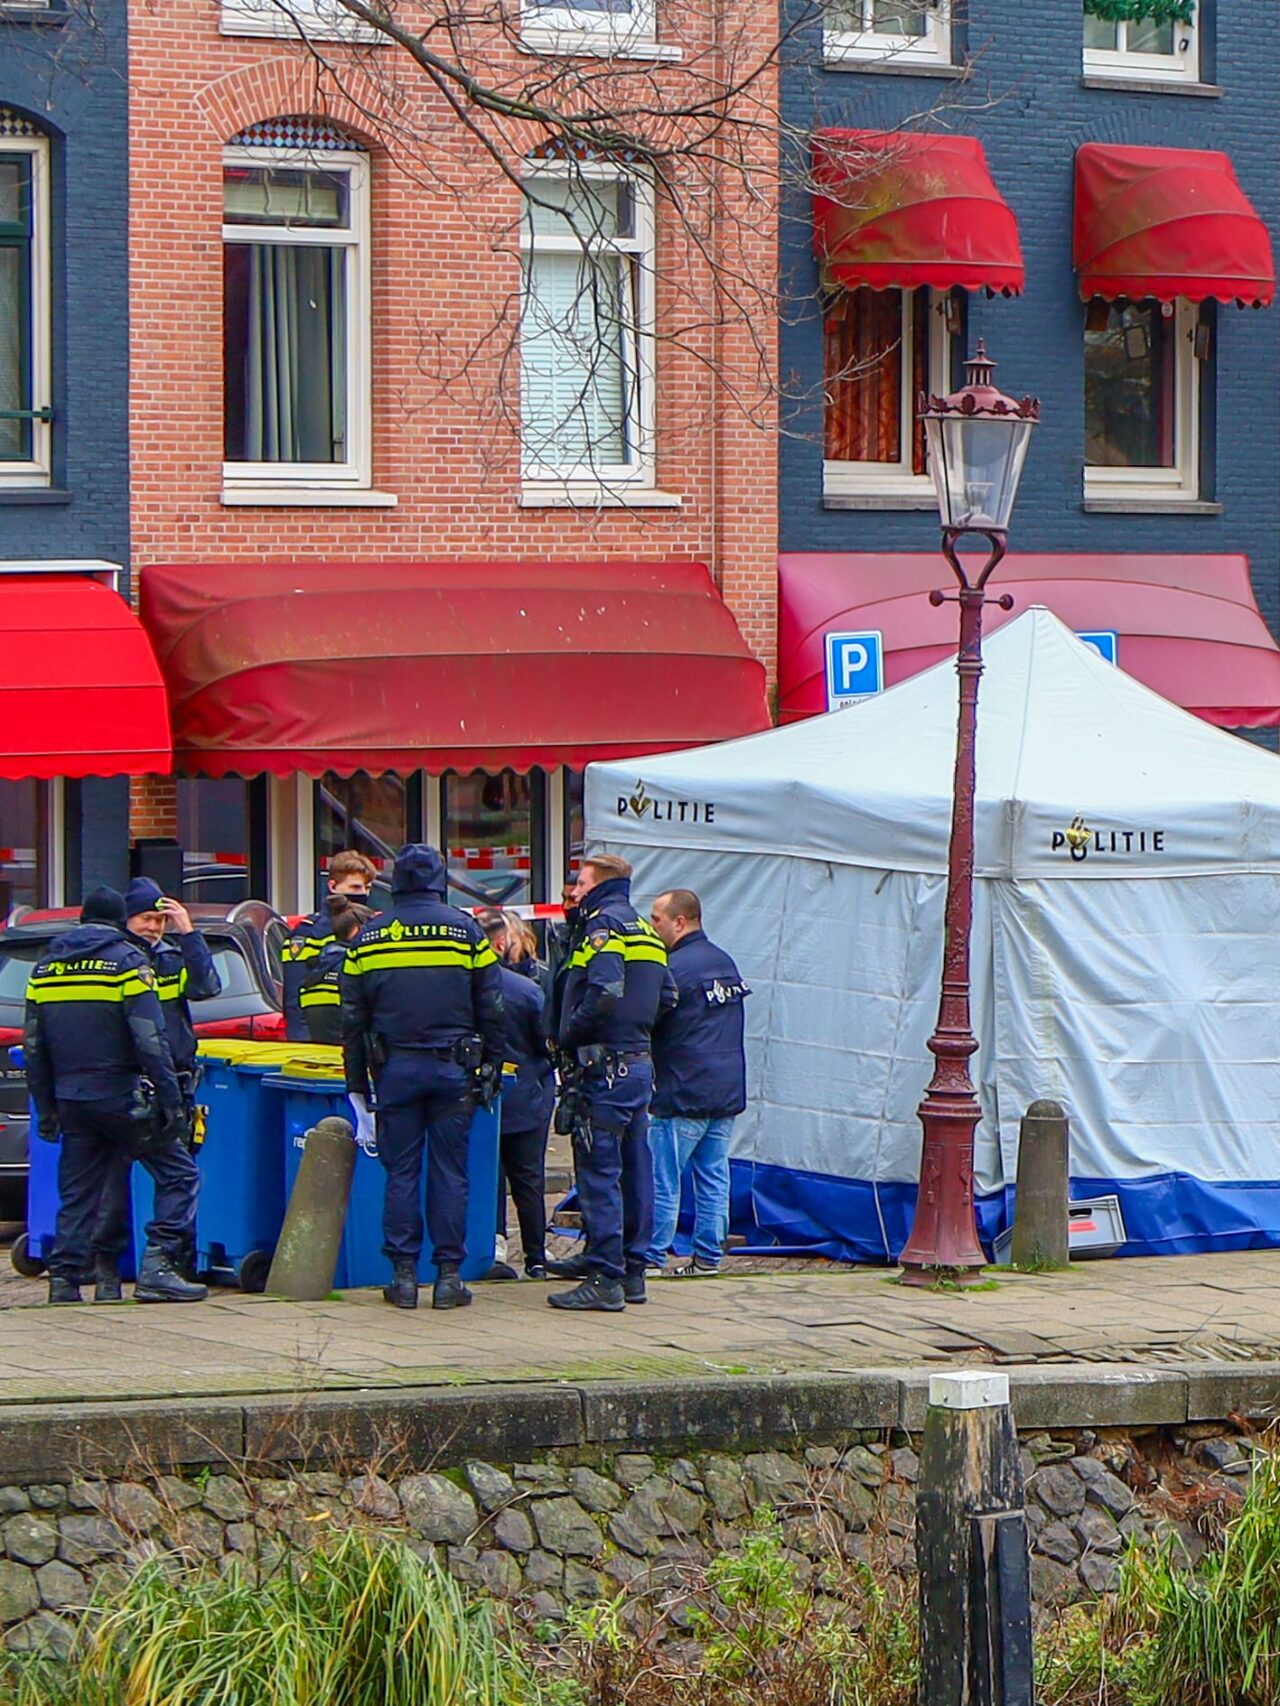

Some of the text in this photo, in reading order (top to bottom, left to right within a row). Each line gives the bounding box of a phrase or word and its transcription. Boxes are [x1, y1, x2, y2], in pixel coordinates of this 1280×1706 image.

[841, 643, 868, 689] P
[617, 784, 715, 823] PLITIE
[1051, 820, 1165, 862] POLITIE
[380, 919, 448, 941] POLITIE
